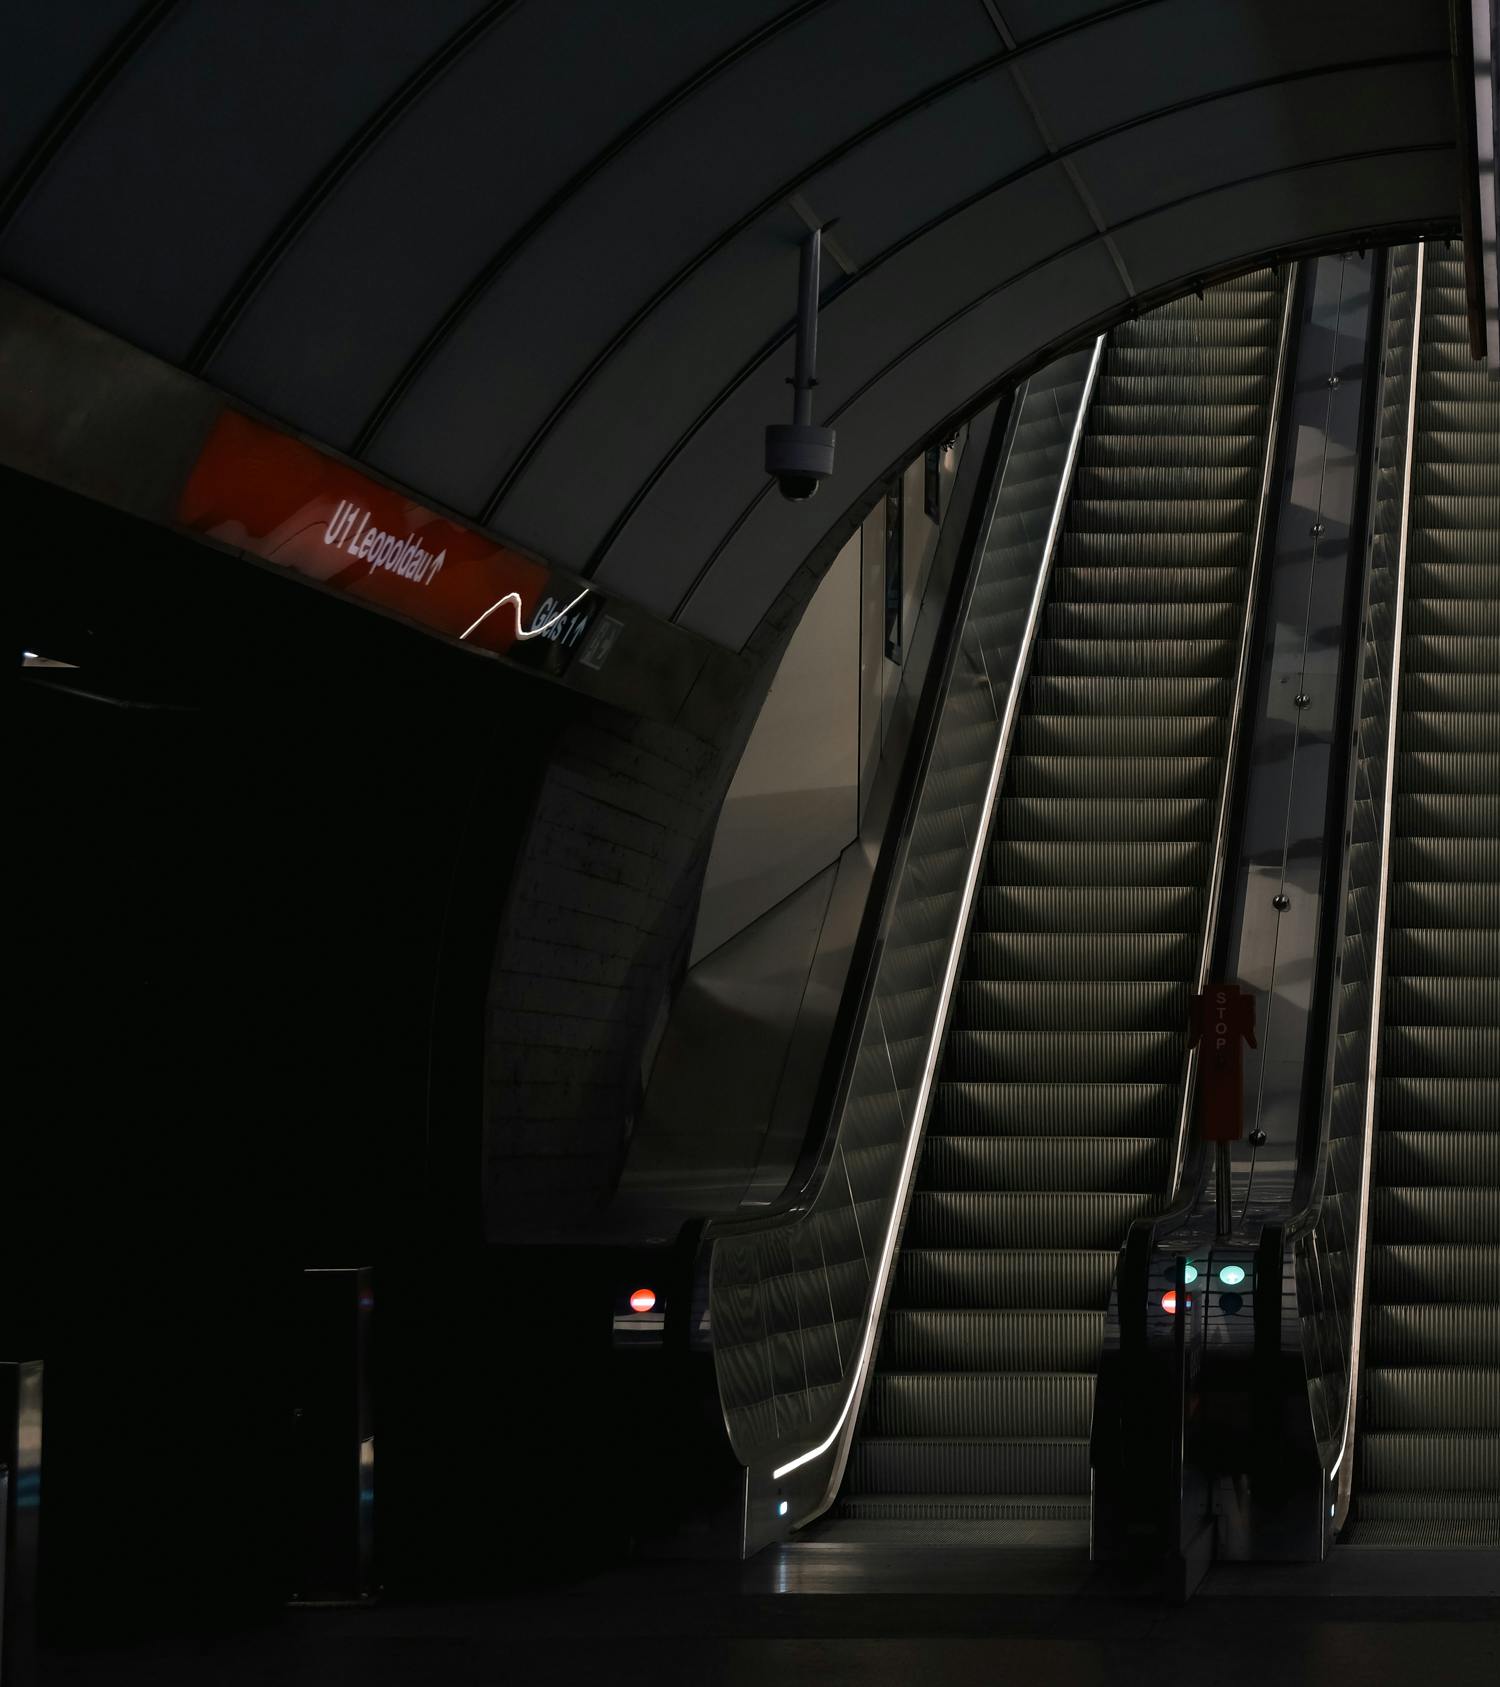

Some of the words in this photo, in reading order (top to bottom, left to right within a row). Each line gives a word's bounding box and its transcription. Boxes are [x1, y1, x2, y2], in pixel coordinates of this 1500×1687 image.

[324, 499, 360, 548] U1
[347, 511, 435, 583] Leopoldau
[561, 611, 582, 645] 1
[1215, 992, 1228, 1049] STOP
